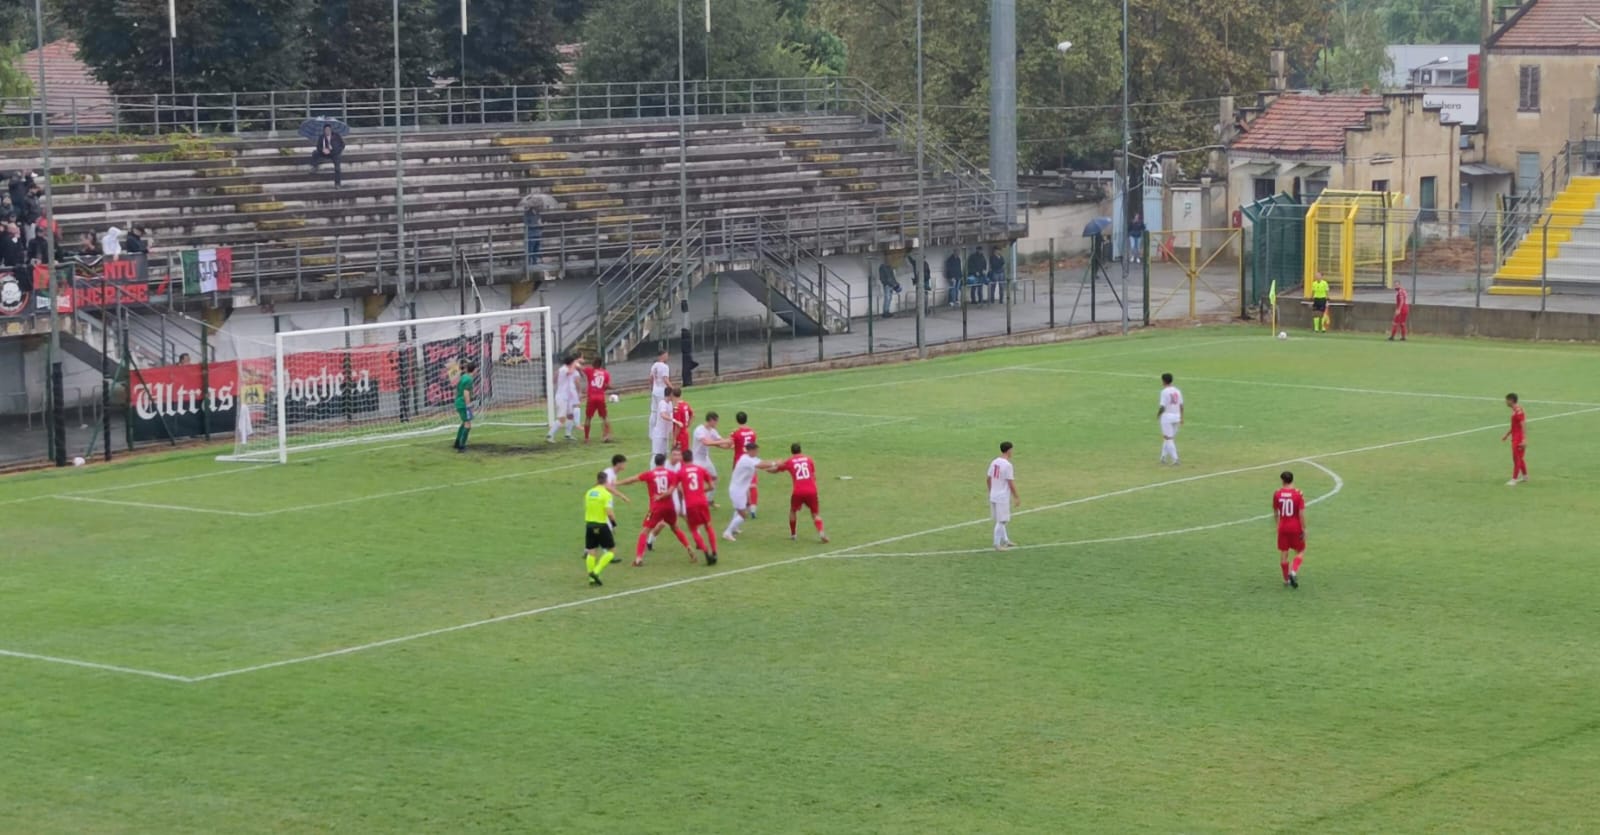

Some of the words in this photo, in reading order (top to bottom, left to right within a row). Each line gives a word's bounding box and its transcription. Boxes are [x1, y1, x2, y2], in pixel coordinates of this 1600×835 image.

[591, 374, 605, 389] 30
[134, 381, 234, 420] Ultras
[794, 462, 810, 480] 26
[654, 475, 668, 494] 19
[688, 472, 698, 491] 3
[1279, 498, 1294, 517] 70
